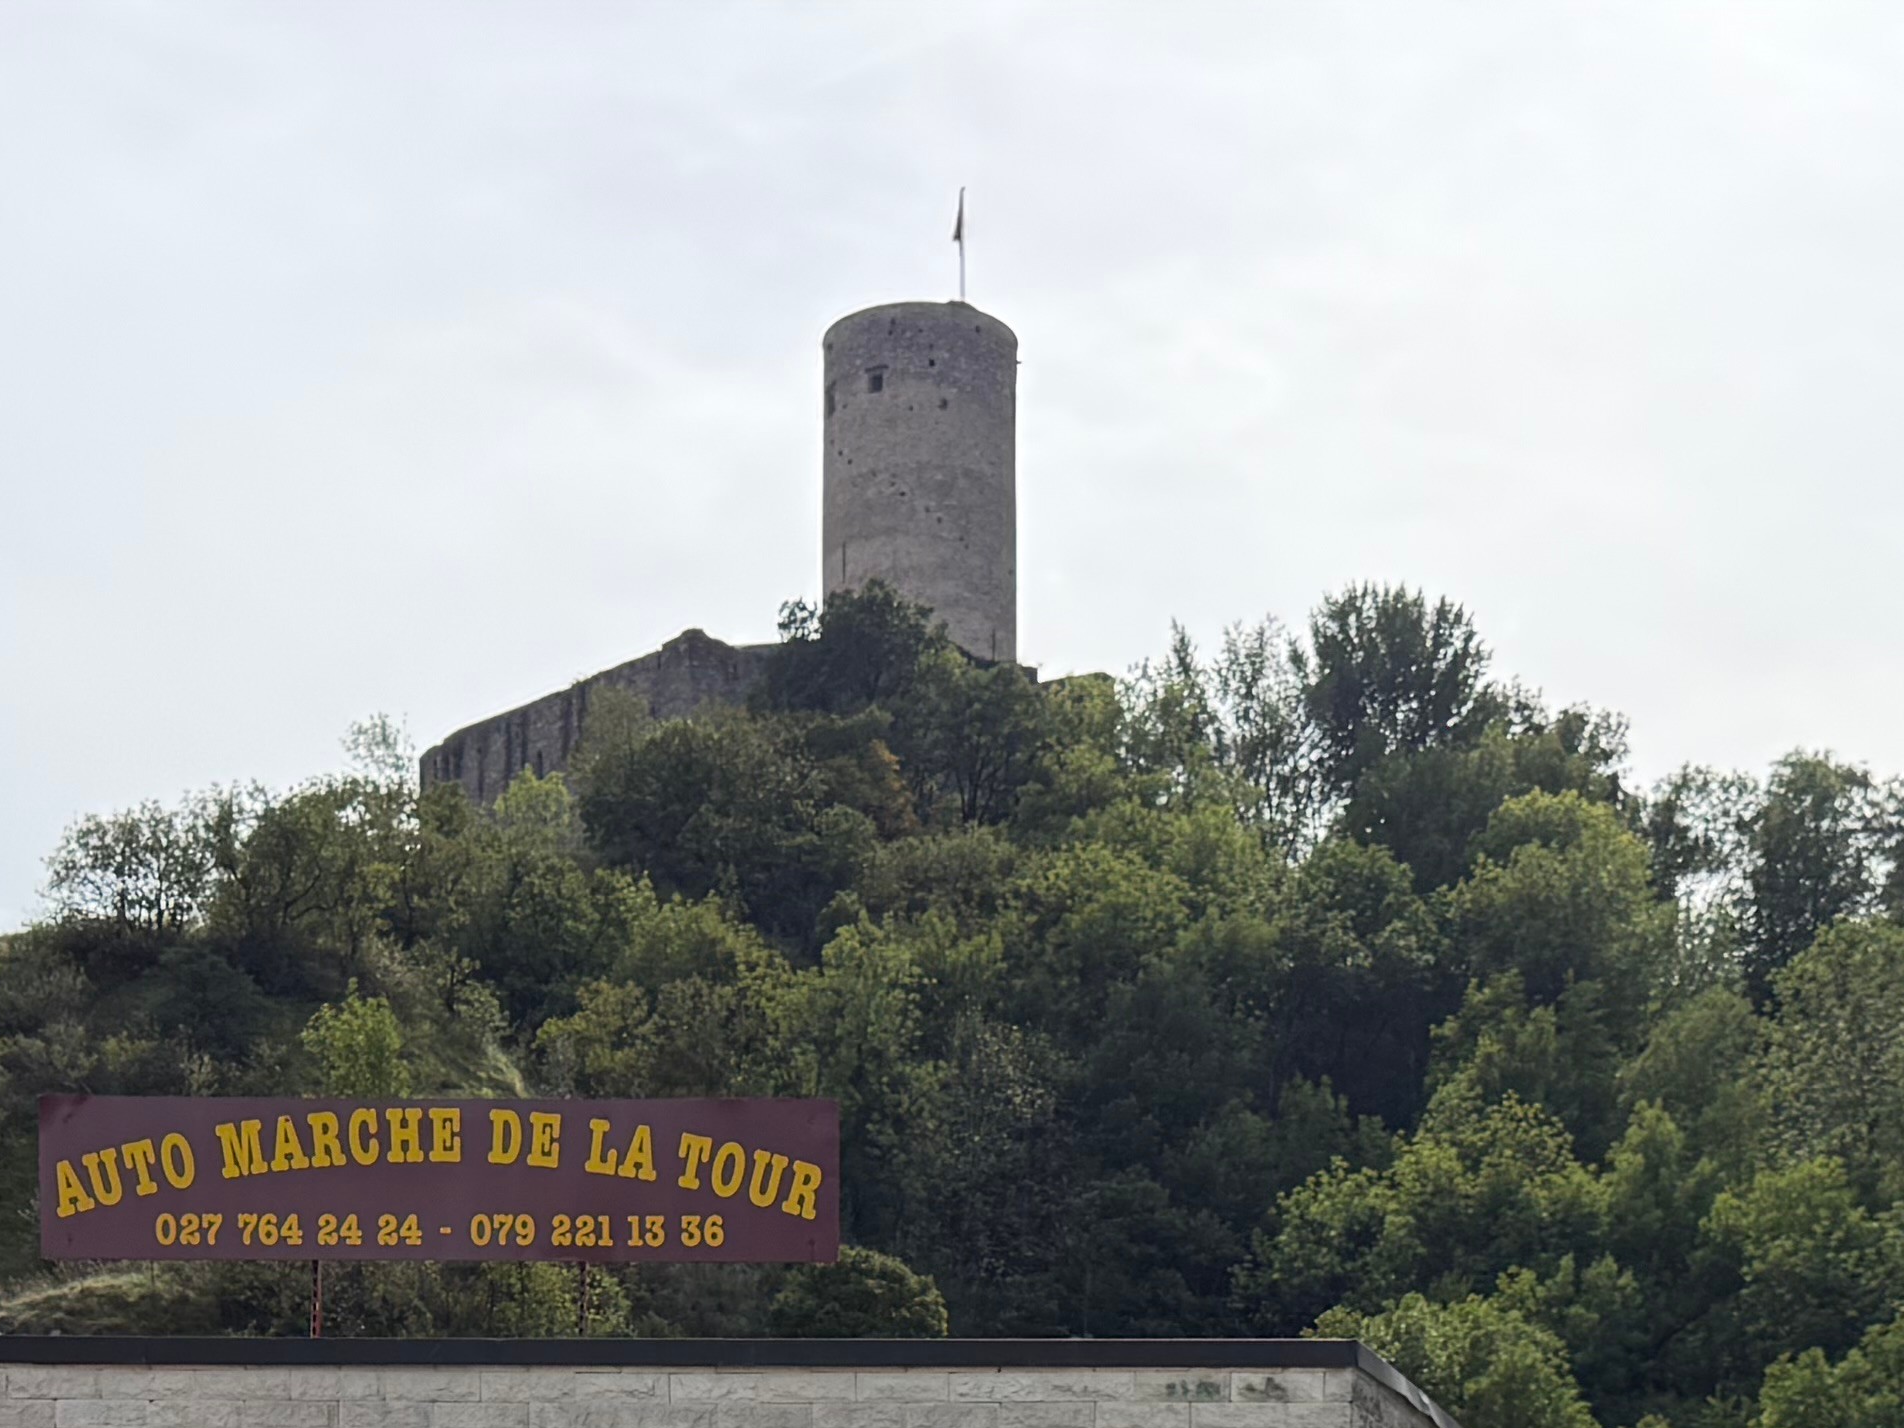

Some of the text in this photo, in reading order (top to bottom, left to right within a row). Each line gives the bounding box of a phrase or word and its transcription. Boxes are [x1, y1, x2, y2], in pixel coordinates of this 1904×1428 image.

[56, 1107, 823, 1221] AUTO MARCHE DE LA TOUR
[155, 1213, 223, 1247] 027
[238, 1213, 302, 1247] 764
[317, 1213, 363, 1247] 24
[377, 1213, 423, 1247] 24
[470, 1213, 536, 1247] 079
[551, 1214, 614, 1248] 221
[627, 1214, 667, 1248] 13
[681, 1214, 725, 1248] 36
